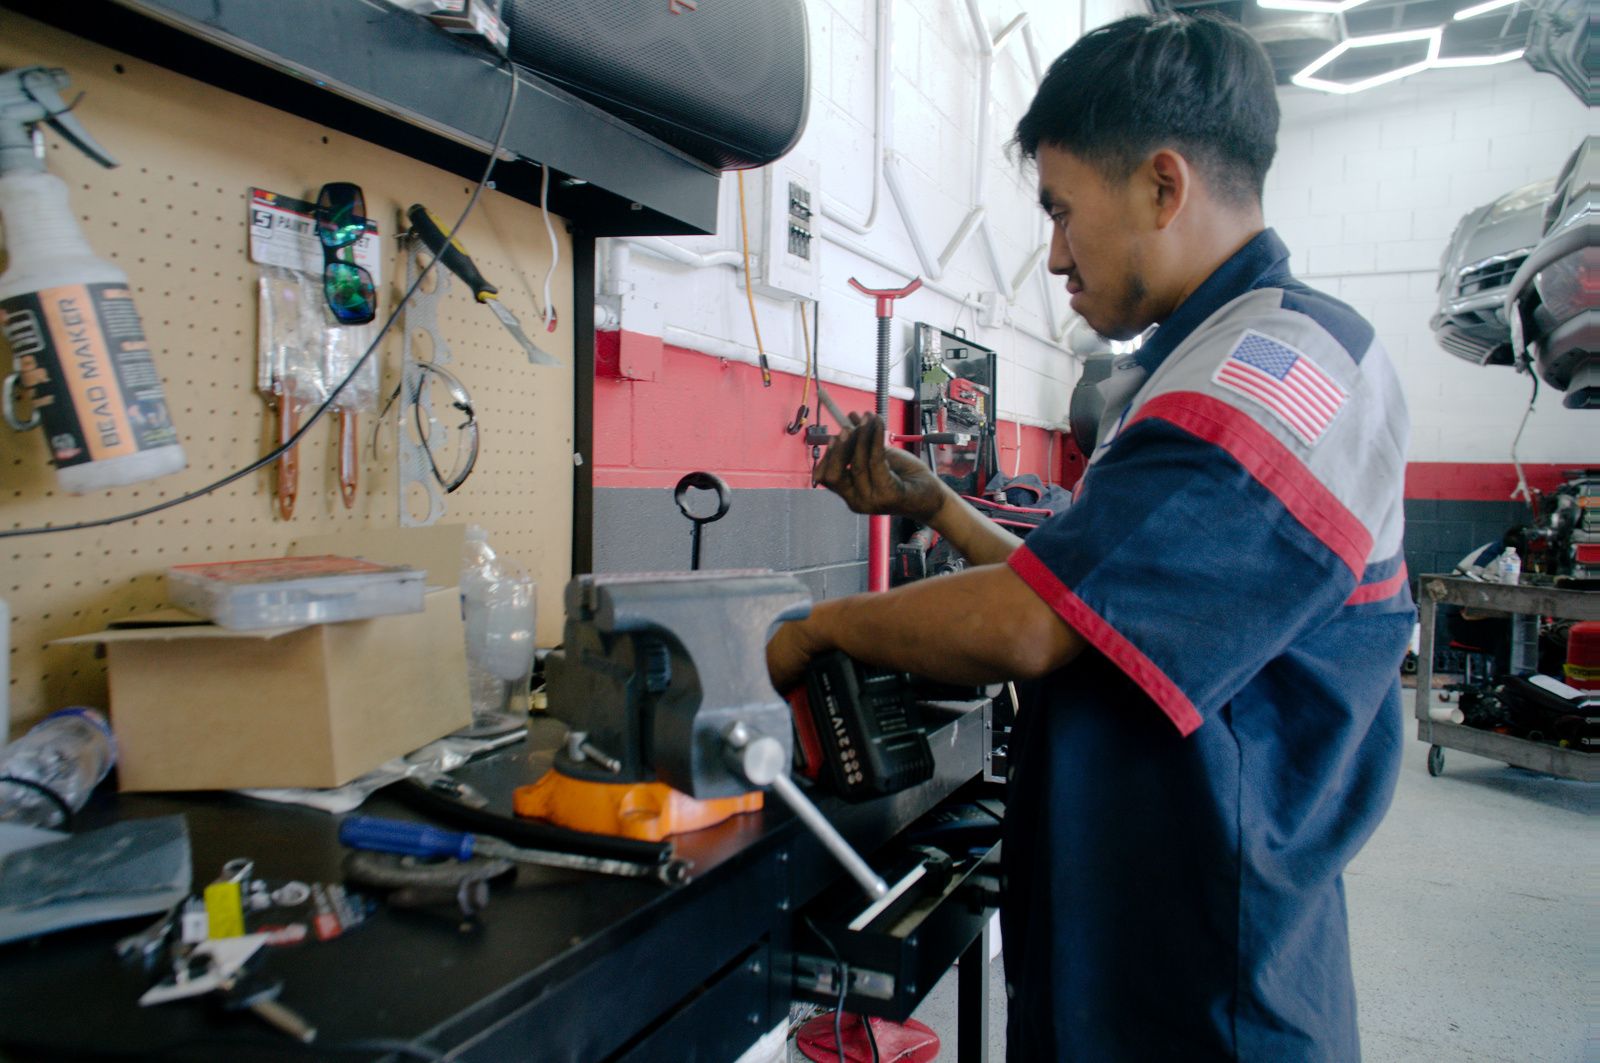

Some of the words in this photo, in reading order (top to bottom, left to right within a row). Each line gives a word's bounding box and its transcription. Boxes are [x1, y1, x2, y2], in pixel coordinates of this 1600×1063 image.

[58, 298, 99, 380] MAKER
[86, 386, 121, 448] BEAD
[831, 717, 850, 747] 21V
